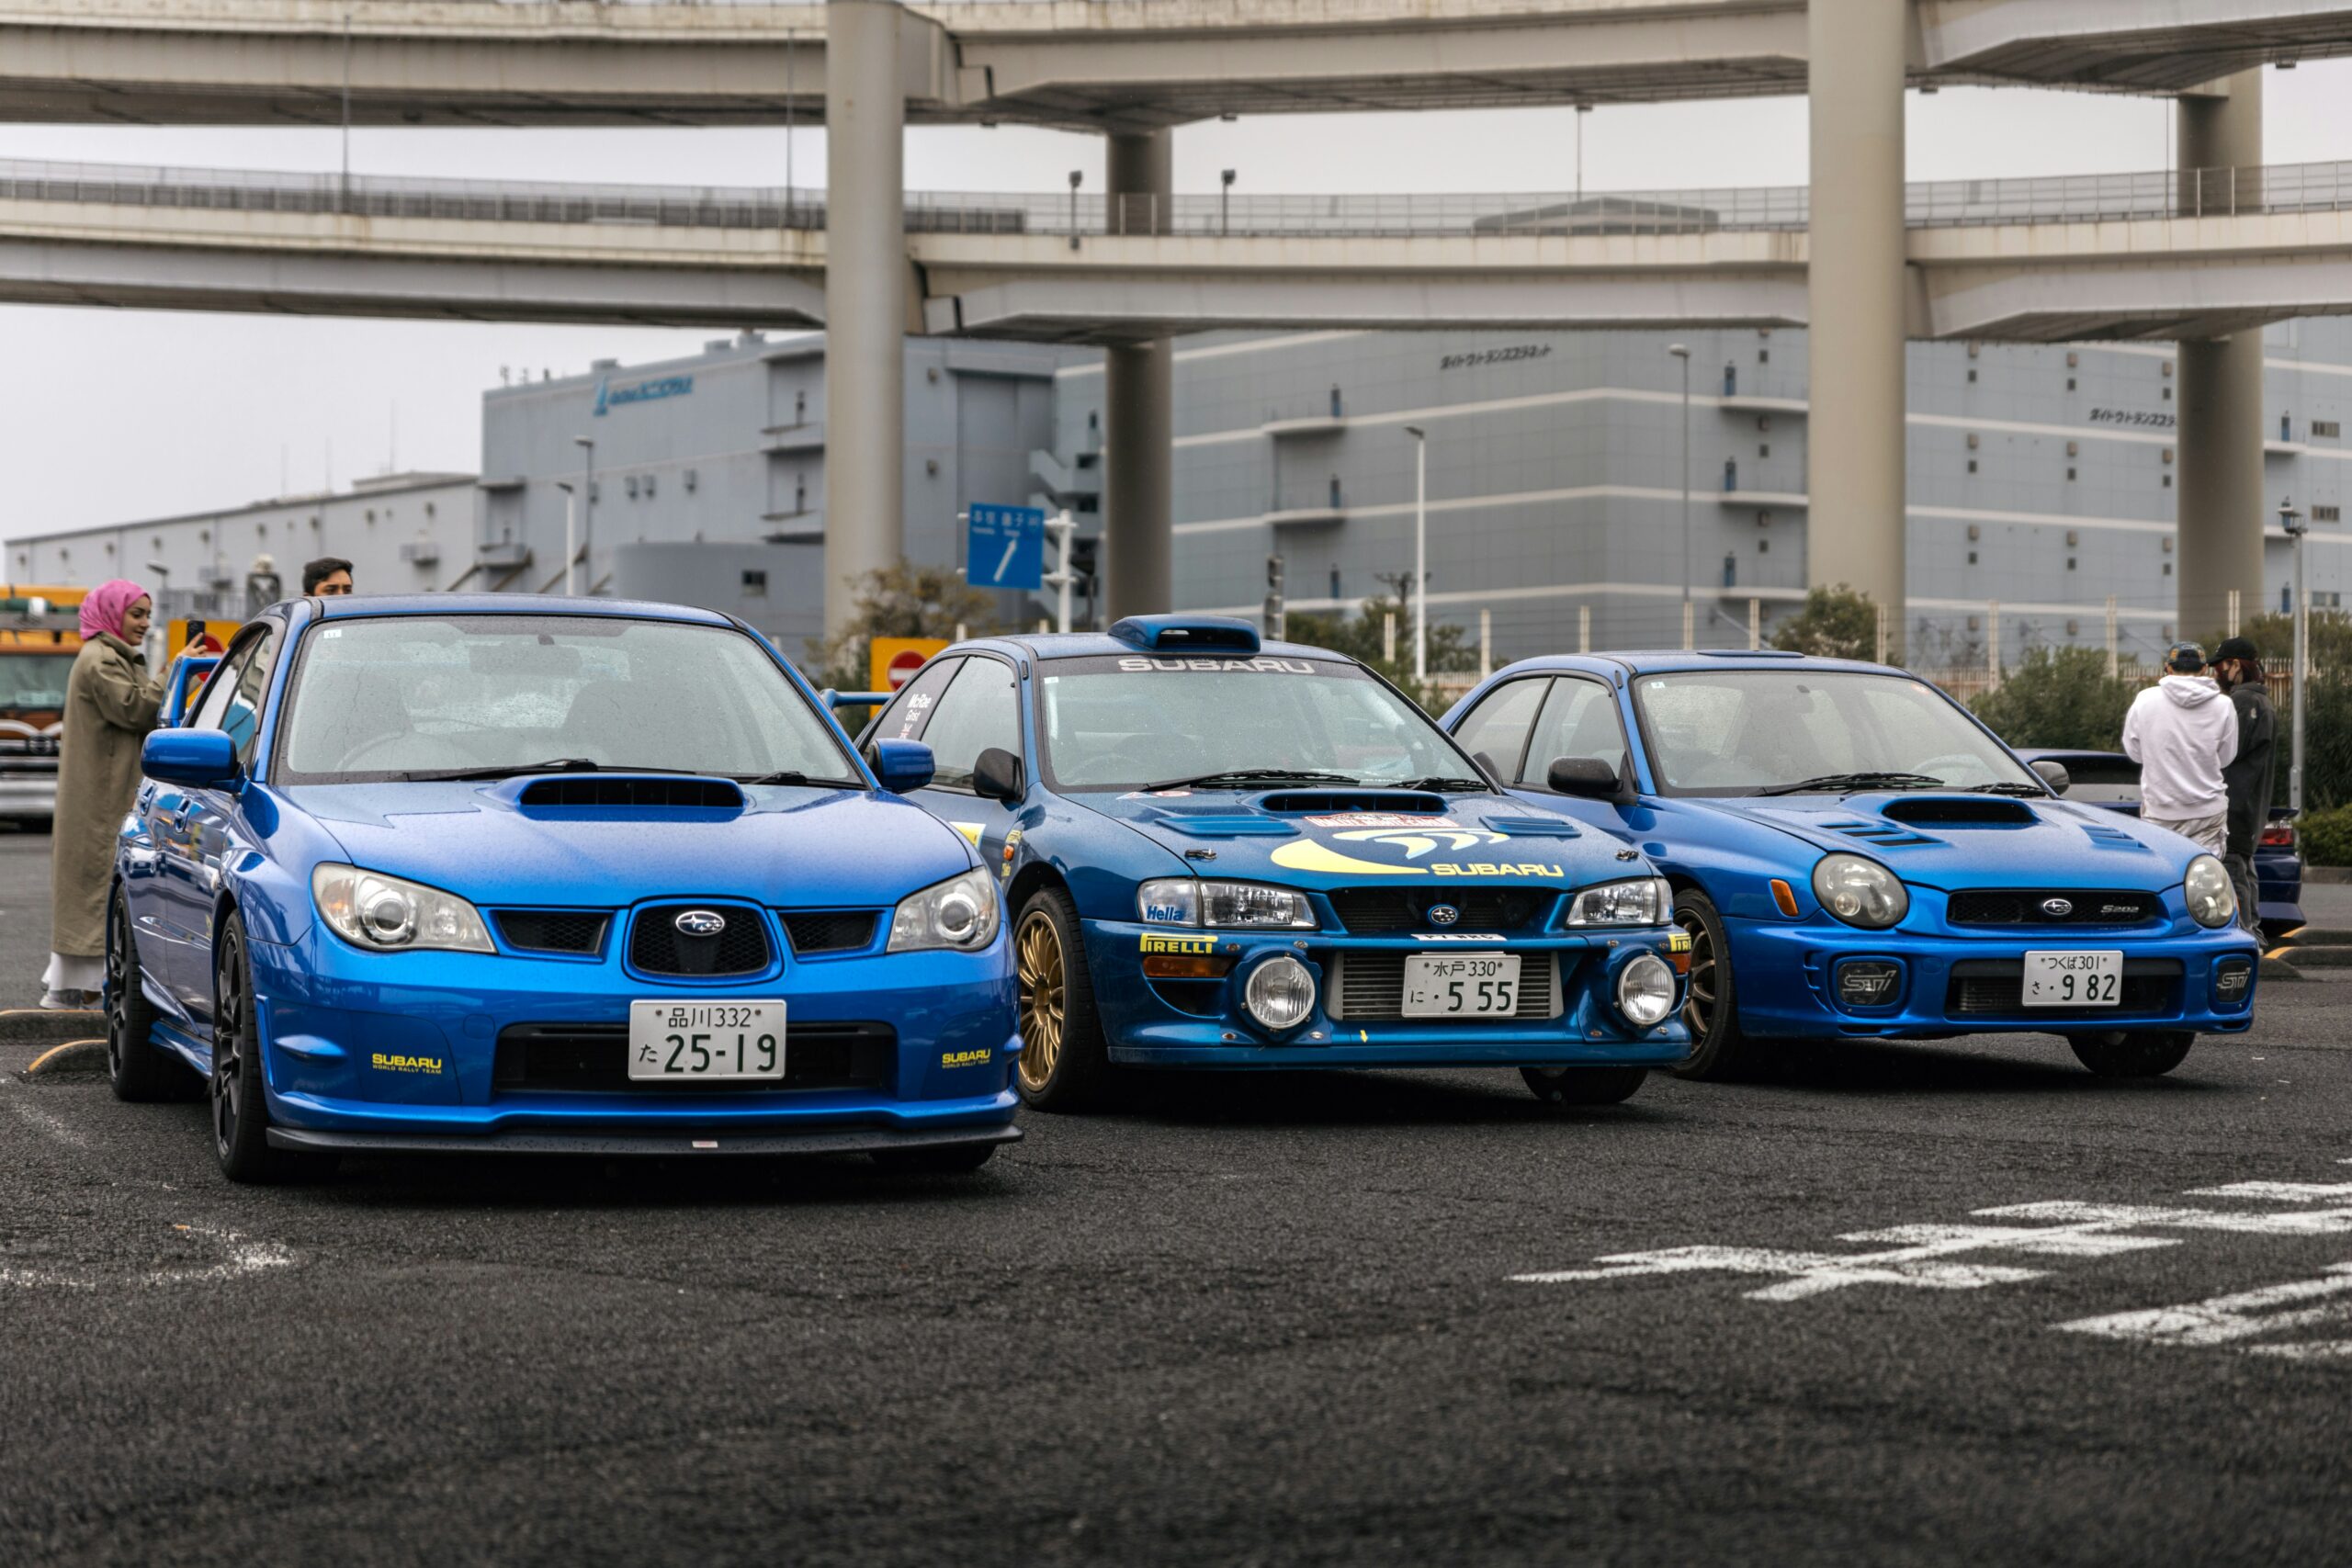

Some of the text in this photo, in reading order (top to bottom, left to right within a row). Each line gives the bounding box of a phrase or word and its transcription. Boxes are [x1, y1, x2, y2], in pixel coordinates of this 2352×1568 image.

[1118, 659, 1315, 674] SUBARU
[1430, 863, 1564, 876] SUBARU
[1147, 905, 1183, 920] Hella
[2100, 905, 2139, 913] S202
[1140, 933, 1218, 953] PIRELLI
[2032, 981, 2040, 995] さ
[1410, 990, 1424, 1003] に
[639, 1034, 776, 1073] た 25-19
[943, 1048, 991, 1064] SUBARU
[372, 1054, 441, 1068] SUBARU
